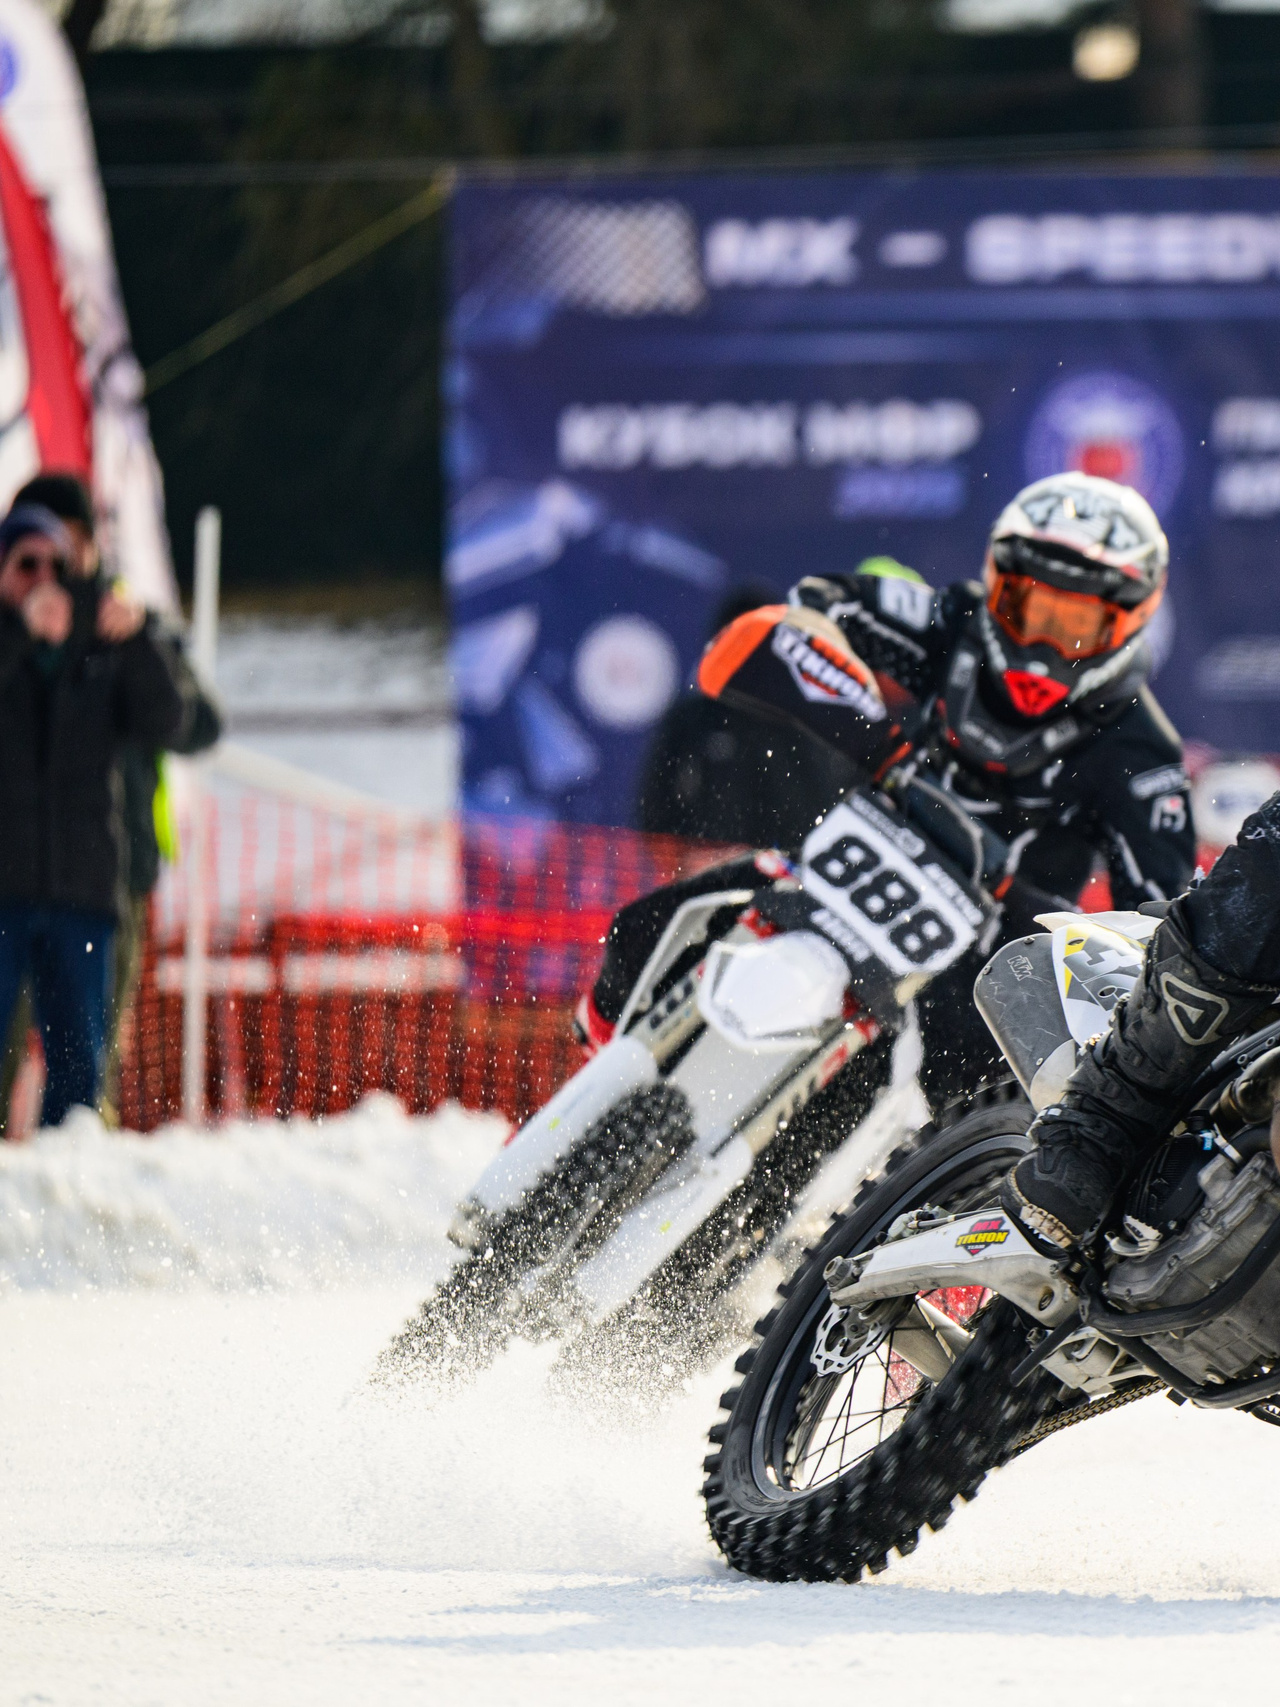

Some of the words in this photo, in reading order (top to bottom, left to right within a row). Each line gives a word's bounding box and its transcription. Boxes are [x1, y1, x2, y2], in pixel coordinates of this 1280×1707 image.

[704, 217, 861, 286] MX
[809, 835, 955, 965] 888
[1007, 955, 1034, 981] KTM
[971, 1219, 1002, 1232] MX
[956, 1231, 1009, 1247] TIKHON
